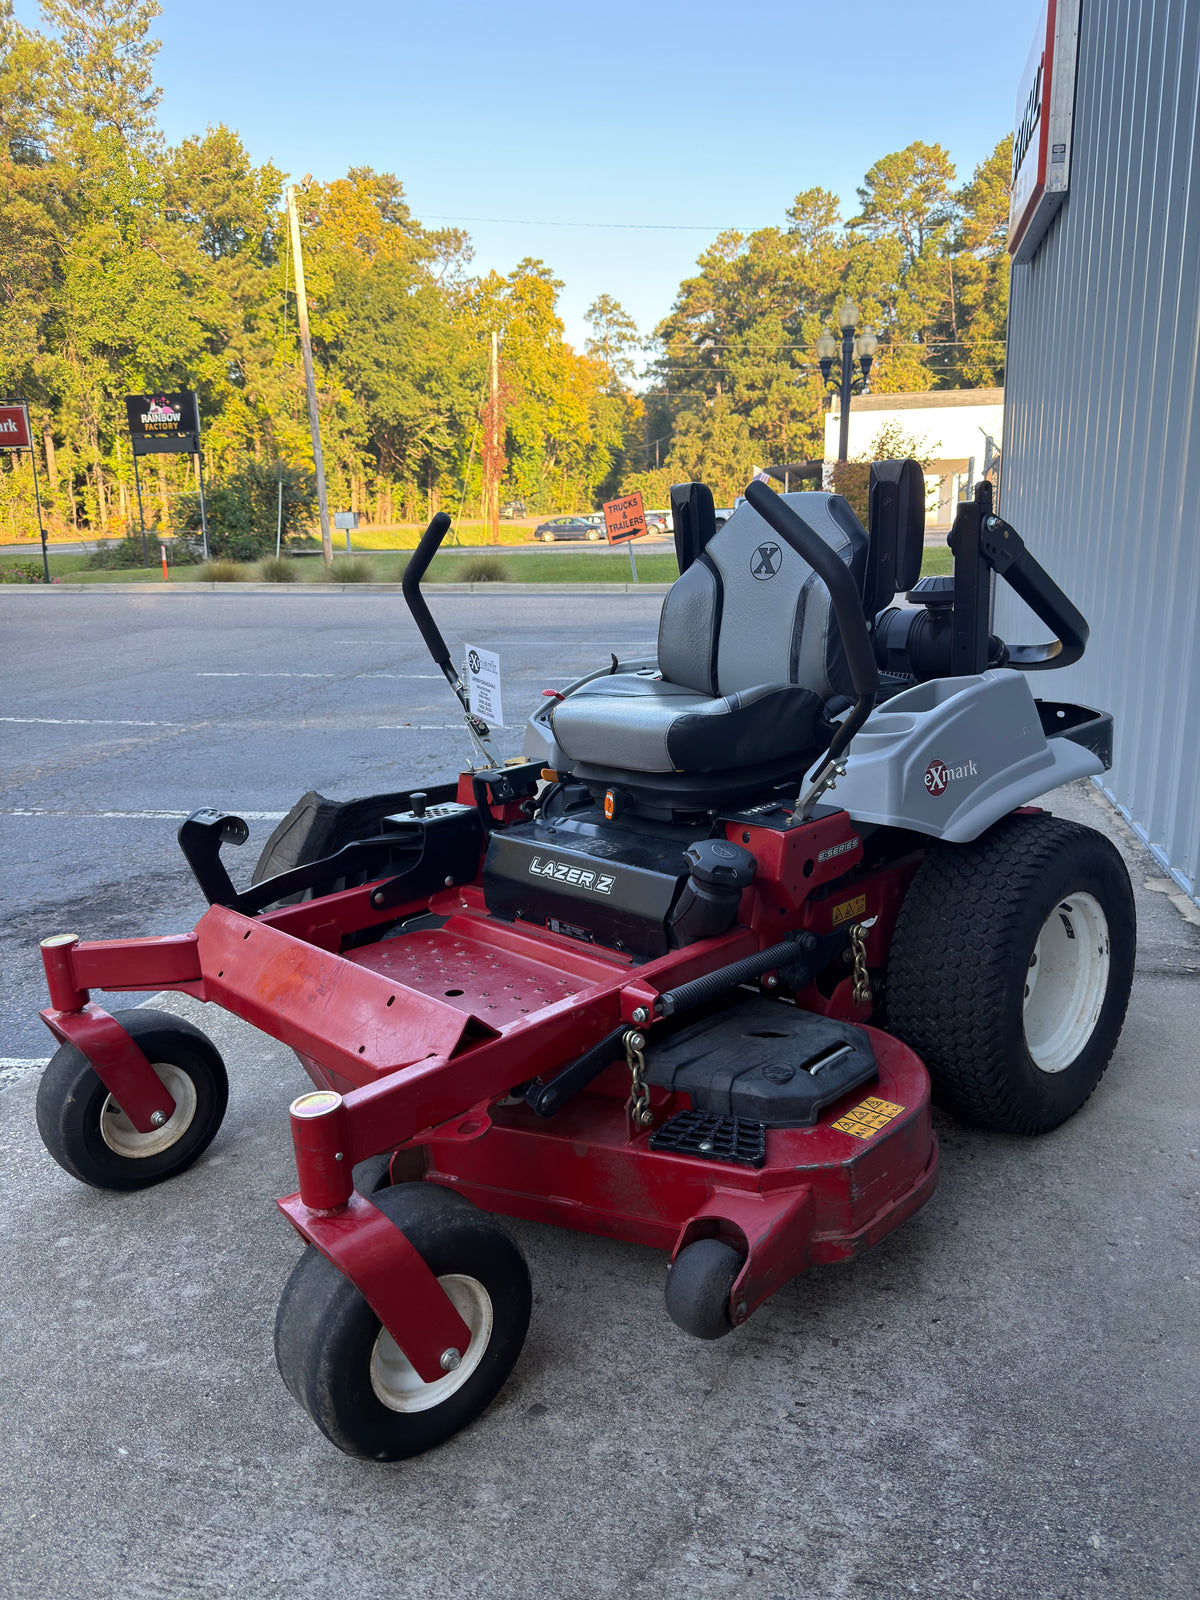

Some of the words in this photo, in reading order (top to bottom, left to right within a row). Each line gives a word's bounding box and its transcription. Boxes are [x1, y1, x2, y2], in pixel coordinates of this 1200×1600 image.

[140, 413, 181, 423] RAINBOW
[144, 422, 178, 431] FACTORY
[608, 498, 638, 514] TRUCKS
[622, 511, 628, 519] &
[608, 516, 644, 533] TRAILERS
[753, 547, 779, 574] X
[924, 759, 978, 792] eXmark
[529, 857, 596, 890] LAZER
[594, 874, 616, 894] Z
